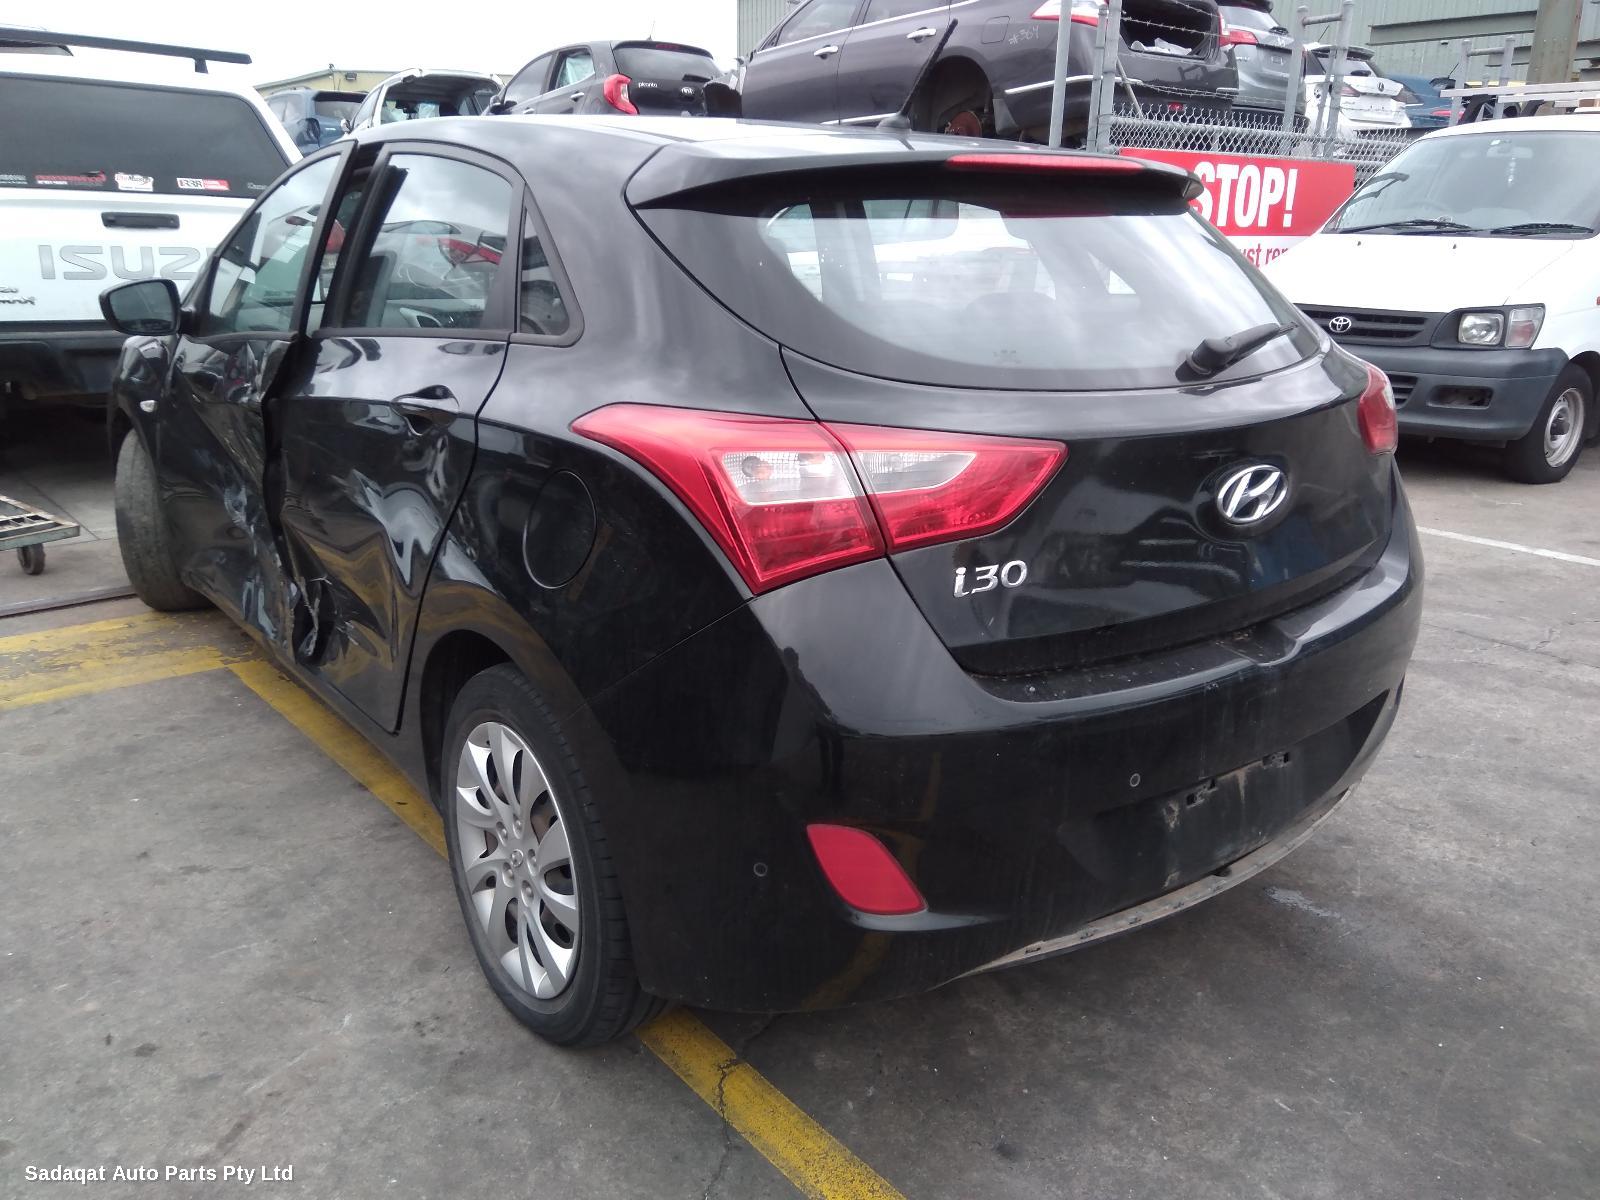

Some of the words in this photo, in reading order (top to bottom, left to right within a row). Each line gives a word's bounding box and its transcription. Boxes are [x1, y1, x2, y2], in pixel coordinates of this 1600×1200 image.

[1192, 161, 1298, 228] STOP!
[38, 245, 216, 280] ISUZ
[953, 560, 1027, 597] i30
